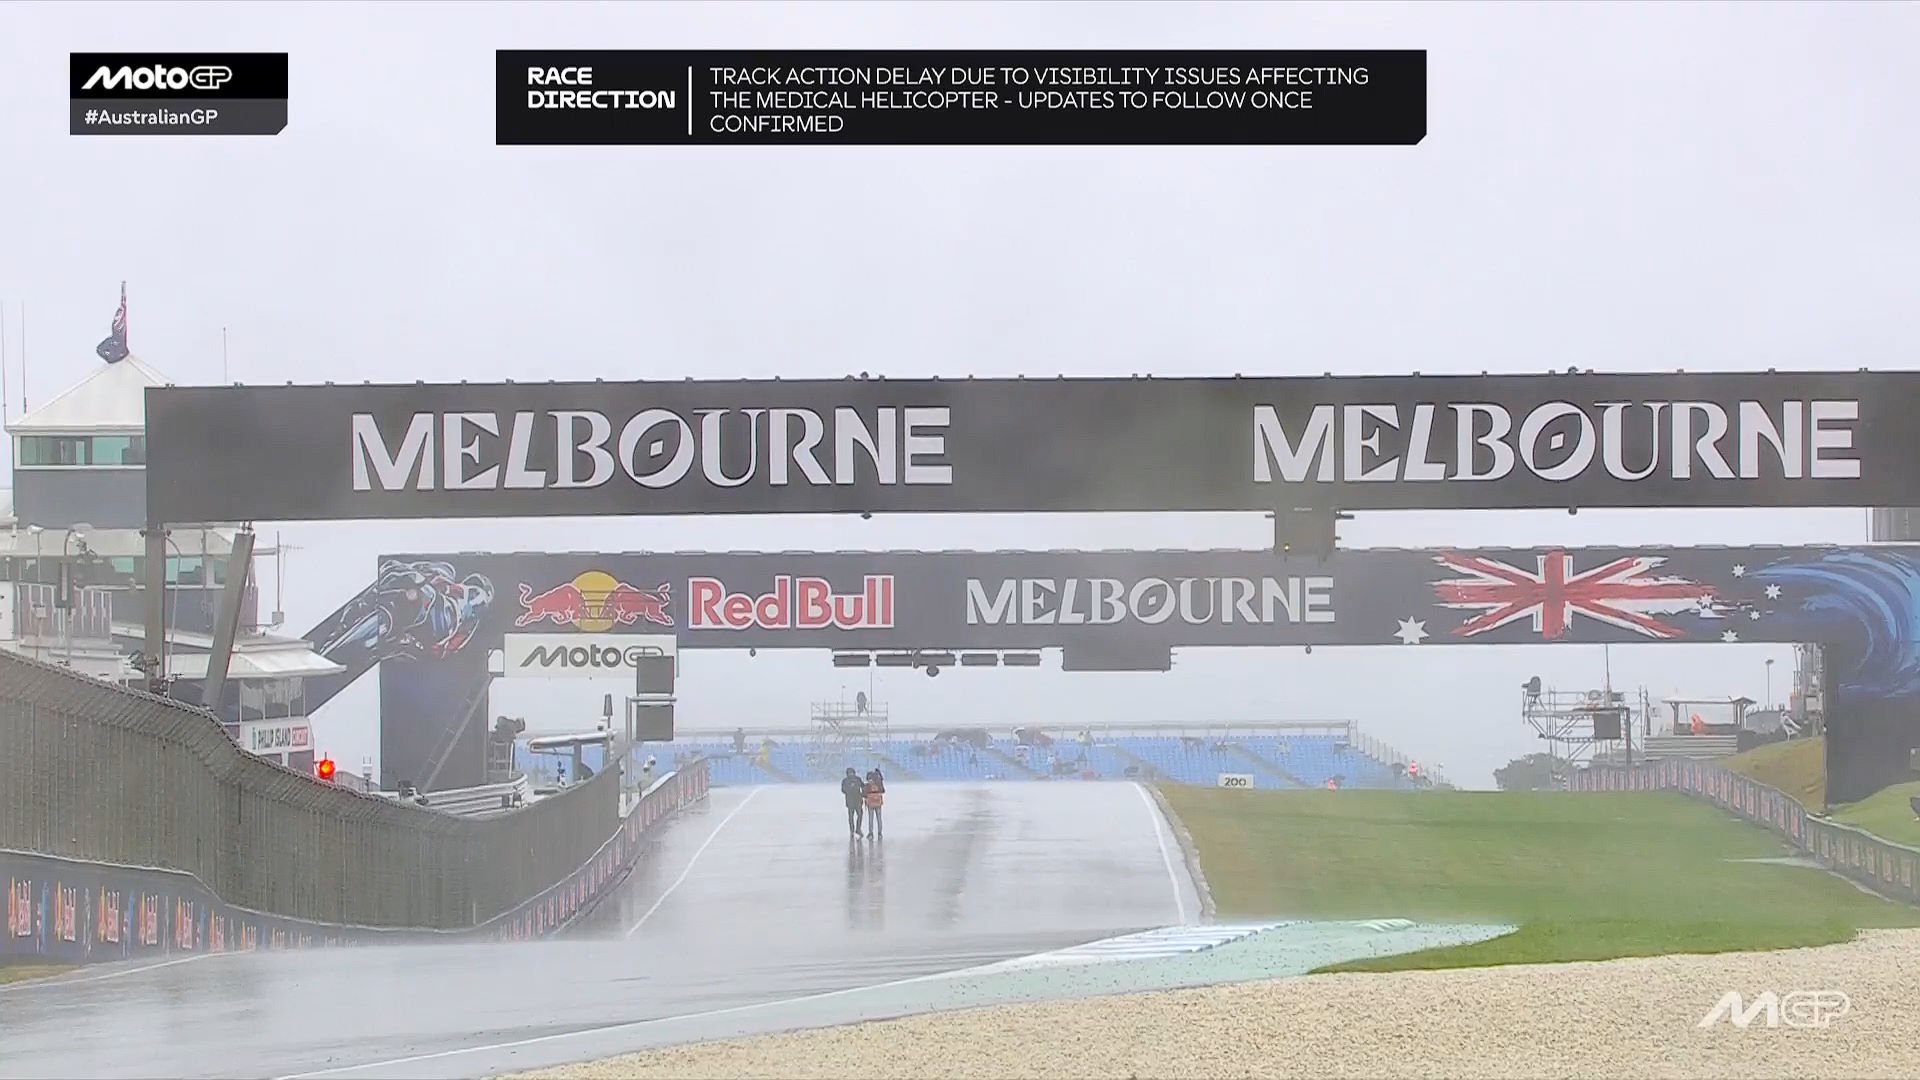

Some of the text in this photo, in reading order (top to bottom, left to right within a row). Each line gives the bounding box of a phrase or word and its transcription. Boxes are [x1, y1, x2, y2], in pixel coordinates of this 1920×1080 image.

[353, 407, 953, 491] MELBOURNE
[1253, 401, 1861, 482] MELBOURNE
[688, 574, 895, 629] Red Bull
[966, 576, 1335, 625] MELBOURNE
[1224, 777, 1247, 787] 200
